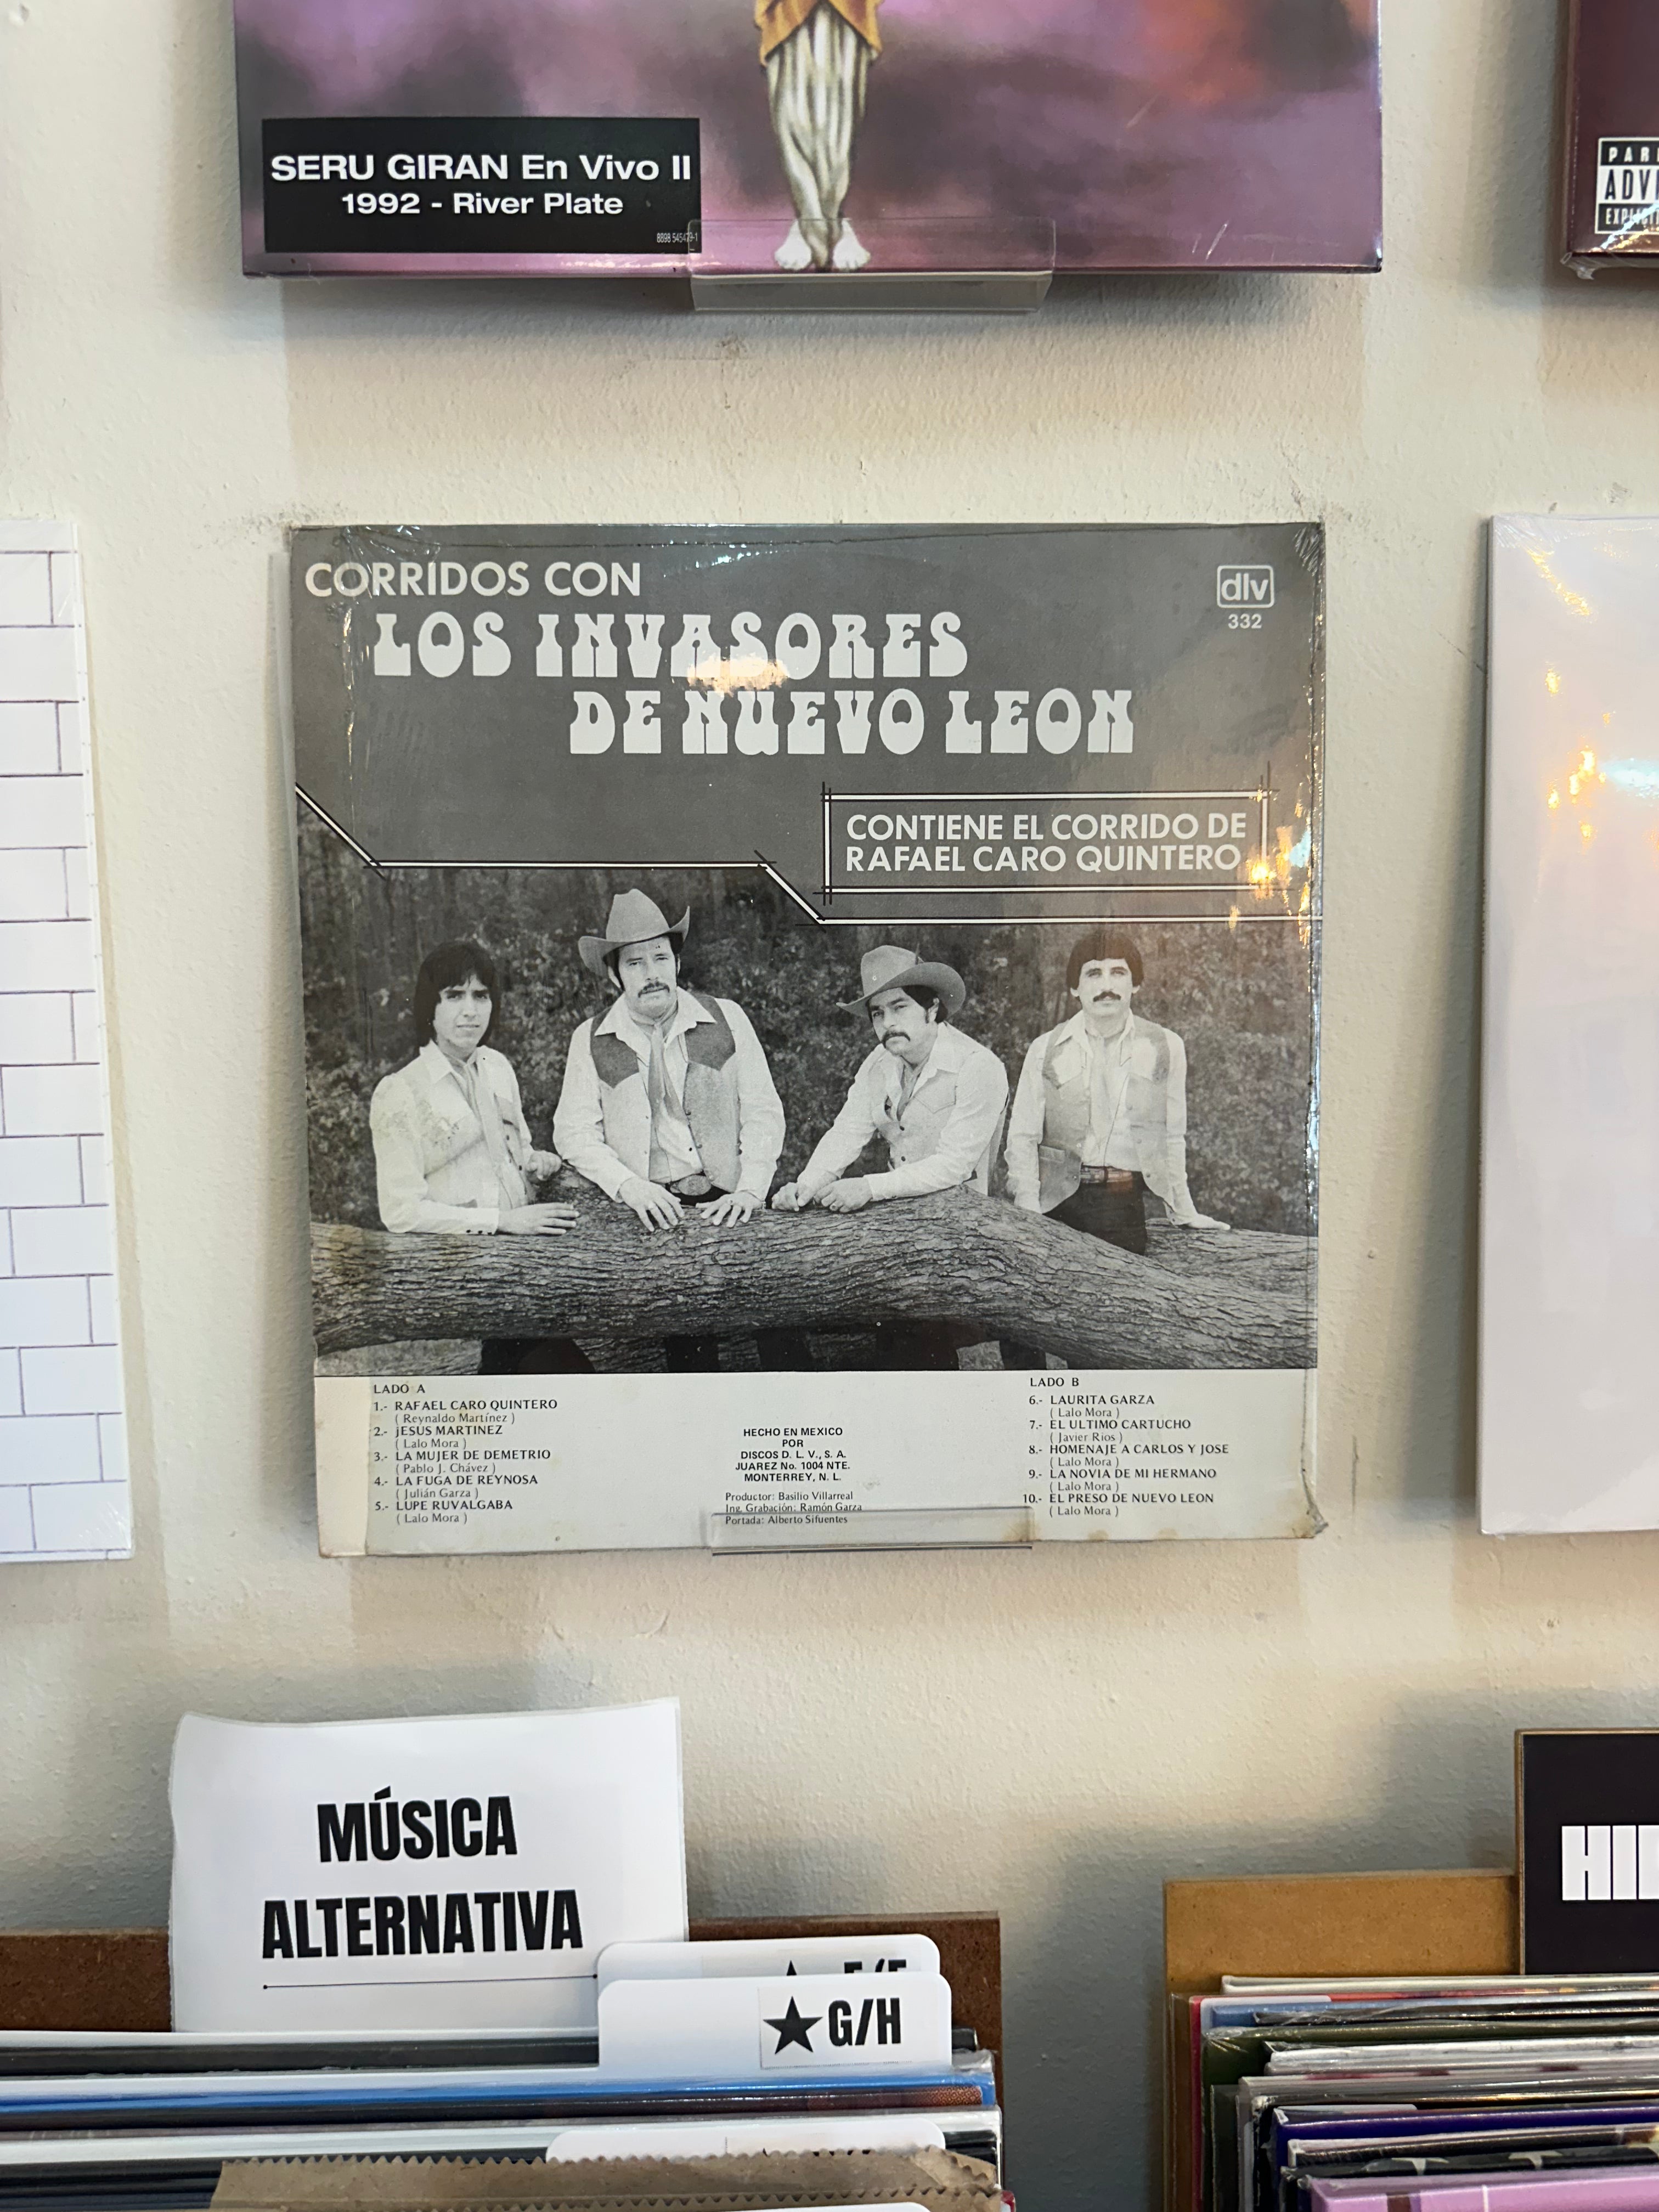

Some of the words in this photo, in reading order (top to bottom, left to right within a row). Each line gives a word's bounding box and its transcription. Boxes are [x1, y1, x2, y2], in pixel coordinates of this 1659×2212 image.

[1609, 146, 1659, 162] PAR
[272, 155, 374, 180] SERU
[388, 154, 507, 180] GIRAN
[522, 155, 567, 180] En
[579, 155, 659, 180] Vivo
[673, 155, 690, 180] II
[342, 193, 420, 214] 1992
[454, 193, 534, 213] River
[544, 193, 623, 214] Plate
[657, 233, 671, 242] 8898
[306, 561, 529, 599] CORRIDOS
[545, 562, 640, 596] CON
[1221, 573, 1268, 600] dlv
[1228, 614, 1261, 629] 332
[374, 612, 511, 678] LOS
[537, 612, 968, 679] INVASORES
[570, 690, 661, 754] DE
[682, 686, 924, 755] NUEVO
[946, 688, 1133, 754] LEON
[847, 814, 1002, 840] CONTIENE
[1014, 814, 1043, 840] EL
[1052, 814, 1199, 840] CORRIDO
[1209, 813, 1246, 840] DE
[847, 845, 965, 871] RAFAEL
[973, 845, 1066, 872] CARO
[1077, 844, 1241, 874] QUINTERO
[1031, 1378, 1064, 1386] LADO
[1072, 1378, 1079, 1386] B
[374, 1384, 409, 1393] LADO
[417, 1384, 425, 1393] A
[1029, 1396, 1042, 1404] 6.-
[1051, 1396, 1106, 1404] LAURITA
[1110, 1395, 1154, 1404] GARZA
[374, 1402, 387, 1410] 1.-
[396, 1401, 447, 1410] RAFAEL
[451, 1401, 486, 1409] CARO
[490, 1400, 557, 1411] QUINTERO
[1059, 1408, 1081, 1417] Lalo
[1086, 1408, 1111, 1417] Mora
[404, 1414, 455, 1425] Reynaldo
[459, 1413, 507, 1422] Martínez
[1030, 1420, 1042, 1429] 7.-
[1051, 1420, 1065, 1429] EL
[1070, 1420, 1118, 1429] ULTIMO
[1122, 1420, 1190, 1429] CARTUCHO
[374, 1427, 387, 1436] 2.-
[436, 1425, 502, 1435] MARTINEZ
[744, 1428, 780, 1436] HECHO
[404, 1439, 427, 1448] Lalo
[432, 1438, 458, 1447] Mora
[1059, 1432, 1088, 1443] Javier
[808, 1451, 821, 1459] V.,
[1029, 1446, 1042, 1454] 8.-
[1051, 1444, 1116, 1455] HOMENAJE
[1122, 1444, 1129, 1453] A
[1134, 1444, 1183, 1453] CARLOS
[1188, 1444, 1195, 1453] Y
[1201, 1444, 1228, 1455] JOSE
[374, 1452, 387, 1462] 3.-
[396, 1452, 412, 1460] LA
[417, 1451, 458, 1462] MUJER
[464, 1451, 479, 1459] DE
[484, 1450, 550, 1459] DEMETRIO
[1059, 1457, 1081, 1466] Lalo
[1085, 1457, 1111, 1466] Mora
[404, 1464, 435, 1473] Pablo
[438, 1464, 445, 1474] J.
[450, 1463, 488, 1472] Chávez
[736, 1462, 777, 1470] JUAREZ
[745, 1473, 815, 1482] MONTERREY,
[1029, 1470, 1042, 1479] 9.-
[1051, 1470, 1065, 1478] LA
[1070, 1469, 1110, 1478] NOVIA
[1115, 1469, 1130, 1478] DE
[1135, 1469, 1148, 1478] MI
[1154, 1469, 1216, 1478] HERMANO
[374, 1477, 387, 1486] 4.-
[397, 1477, 413, 1486] LA
[417, 1476, 452, 1485] FUGA
[457, 1476, 472, 1485] DE
[478, 1475, 538, 1484] REYNOSA
[1058, 1482, 1081, 1491] Lalo
[1085, 1482, 1111, 1491] Mora
[404, 1488, 436, 1500] Julián
[439, 1488, 470, 1497] Garza
[725, 1492, 774, 1501] Productor:
[812, 1491, 853, 1500] Villarreal
[1024, 1494, 1041, 1503] 10.-
[1050, 1494, 1064, 1503] EL
[1069, 1494, 1108, 1503] PRESO
[1113, 1494, 1127, 1503] DE
[1132, 1493, 1176, 1503] NUEVO
[1181, 1494, 1213, 1503] LEON
[375, 1502, 388, 1510] 5.-
[397, 1501, 427, 1510] LUPE
[433, 1500, 512, 1510] RUVALGABA
[746, 1503, 795, 1512] Grabación:
[800, 1503, 832, 1511] Ramón
[835, 1503, 862, 1511] Garza
[1058, 1506, 1080, 1515] Lalo
[1085, 1506, 1110, 1515] Mora
[405, 1514, 428, 1522] Lalo
[432, 1513, 459, 1522] Mora
[726, 1516, 764, 1525] Portada:
[806, 1515, 847, 1523] Sifuentes
[318, 1786, 517, 1863] MÚSICA
[263, 1889, 583, 1959] ALTERNATIVA
[828, 1997, 901, 2046] G/H
